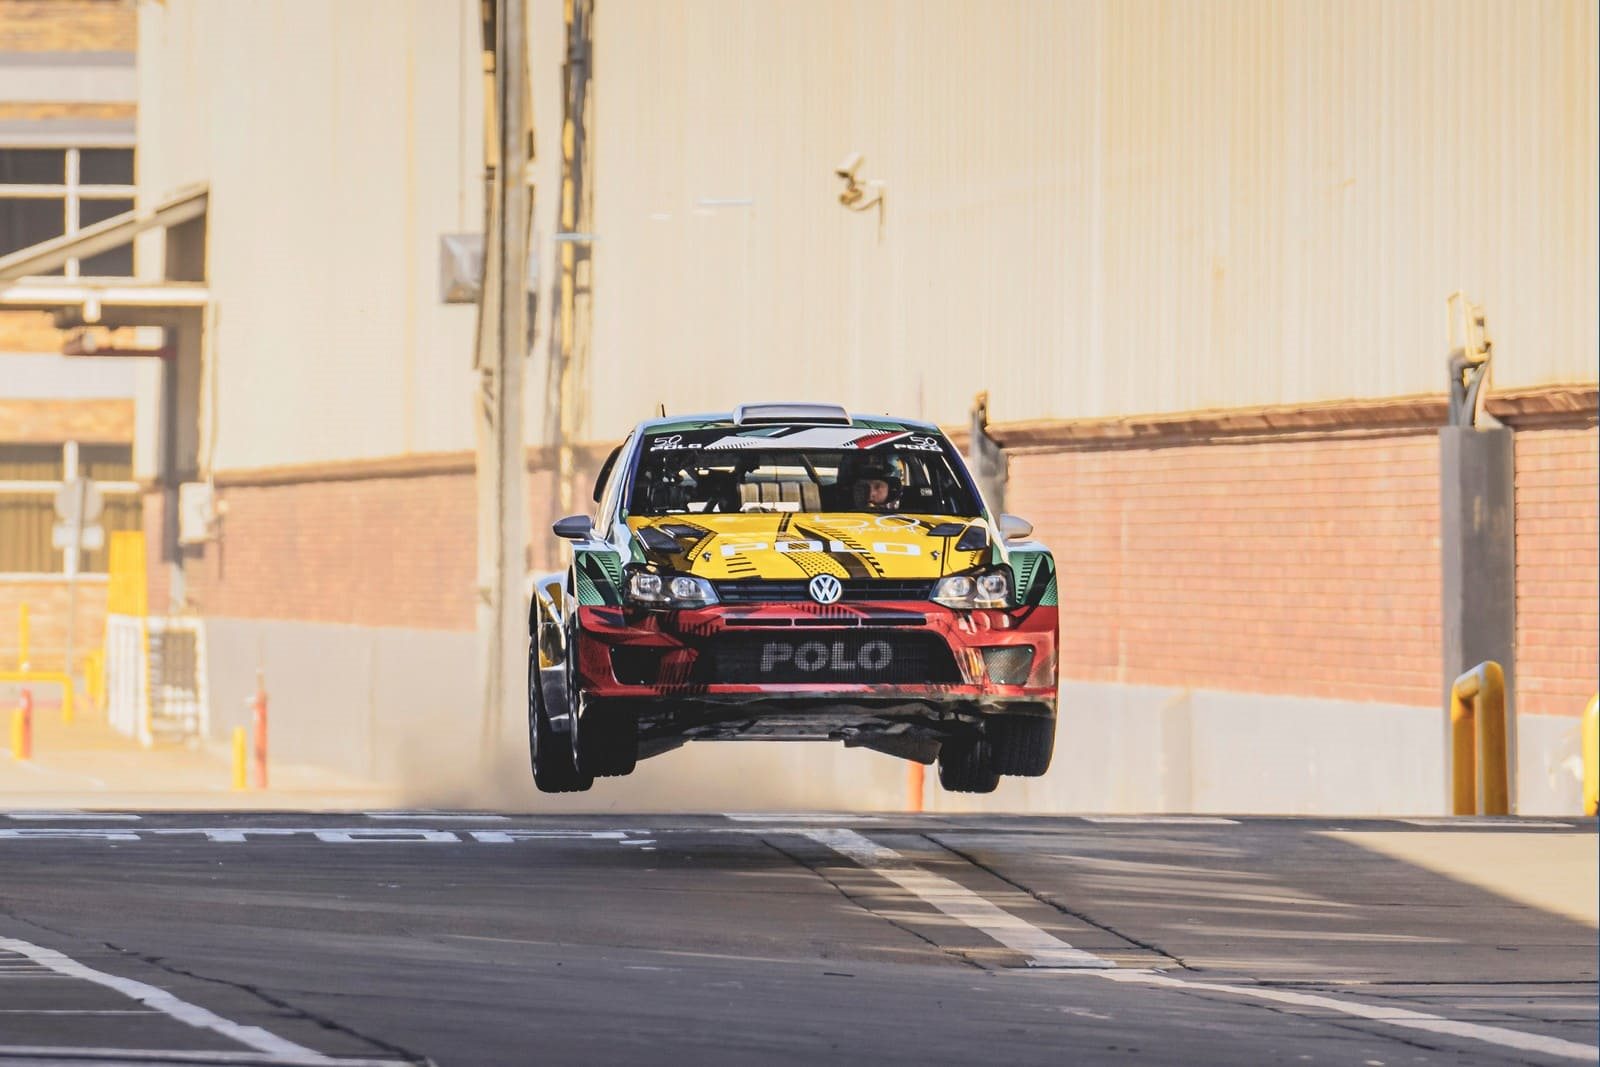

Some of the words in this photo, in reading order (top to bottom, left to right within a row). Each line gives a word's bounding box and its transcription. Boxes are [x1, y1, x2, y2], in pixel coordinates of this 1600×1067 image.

[654, 434, 682, 446] 50
[910, 436, 938, 447] 50
[650, 443, 702, 452] POLO
[893, 443, 943, 452] POLO
[720, 540, 921, 557] POLO
[809, 573, 842, 604] VW
[760, 641, 893, 672] POLO
